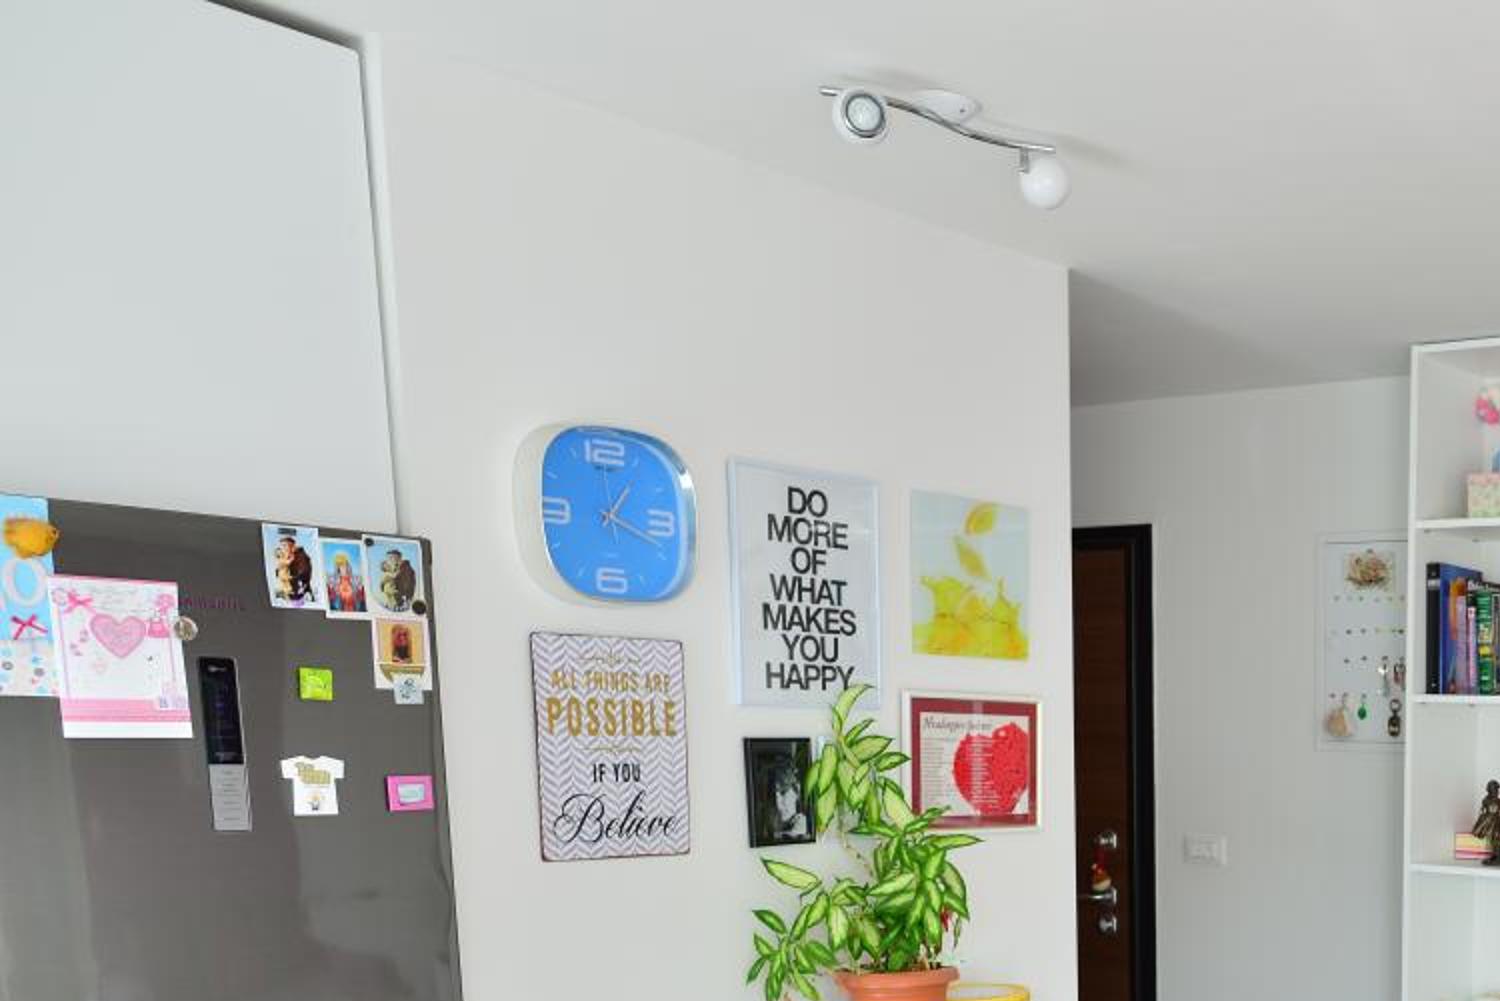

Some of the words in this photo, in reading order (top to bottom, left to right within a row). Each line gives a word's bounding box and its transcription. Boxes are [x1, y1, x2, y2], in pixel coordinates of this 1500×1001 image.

[583, 438, 625, 467] 12
[787, 486, 829, 518] DO
[646, 509, 676, 537] 3
[767, 513, 849, 550] MORE
[790, 547, 827, 575] OF
[595, 566, 629, 594] 6
[769, 573, 848, 607] WHAT
[762, 602, 857, 637] MAKES
[781, 633, 839, 663] YOU
[550, 671, 578, 689] ALL
[584, 672, 638, 692] THINGS
[643, 673, 671, 693] ARE
[765, 661, 855, 691] HAPPY
[545, 697, 677, 736] POSSIBLE
[593, 763, 606, 783] IF
[613, 763, 642, 783] YOU
[553, 789, 677, 843] Believe
